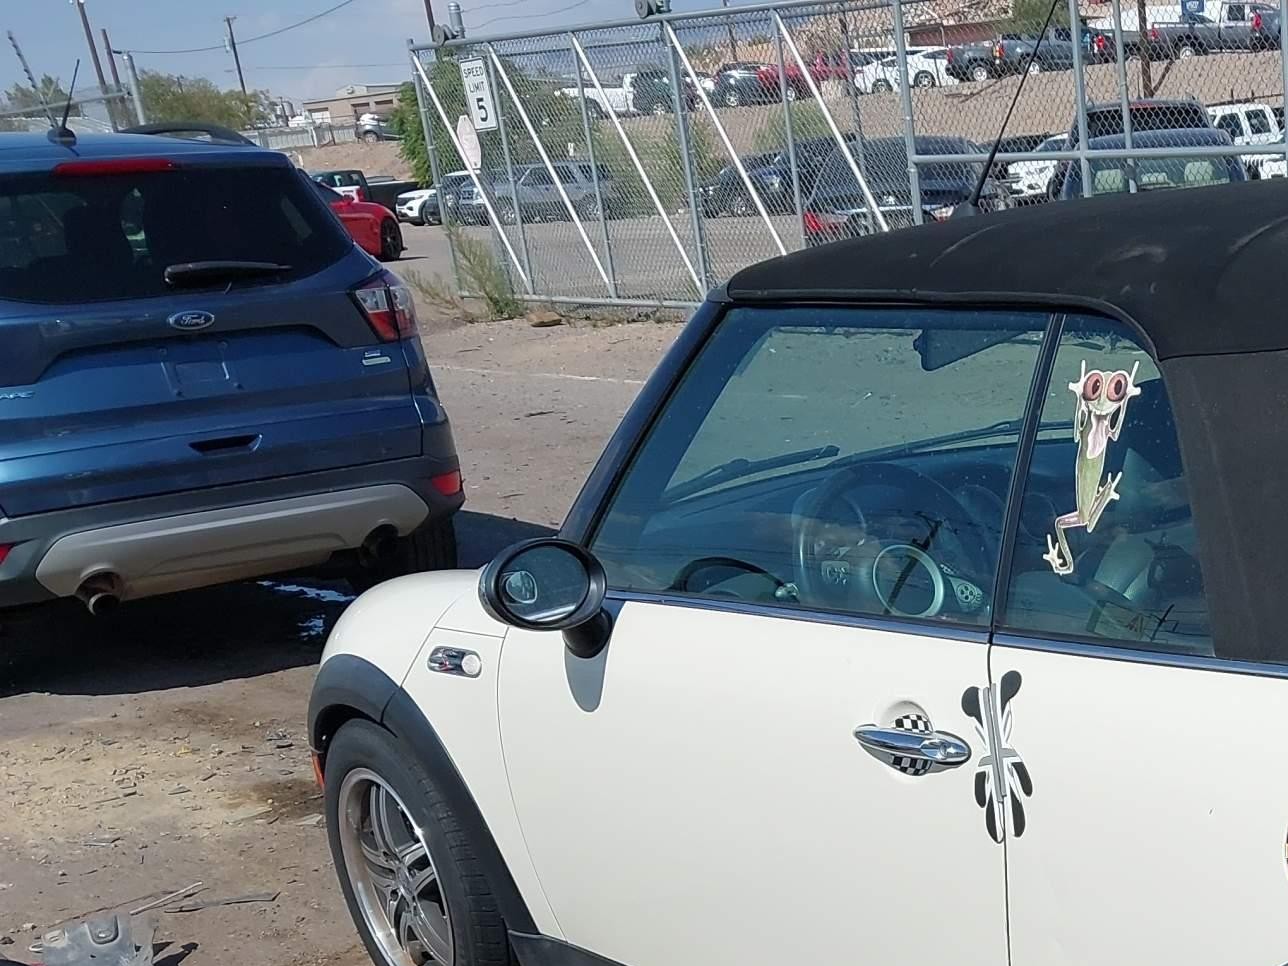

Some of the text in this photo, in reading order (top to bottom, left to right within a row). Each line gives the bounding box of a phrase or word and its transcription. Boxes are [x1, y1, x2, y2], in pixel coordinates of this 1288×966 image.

[463, 66, 484, 79] SPEED
[468, 81, 485, 93] LIMIT
[475, 97, 489, 122] 5
